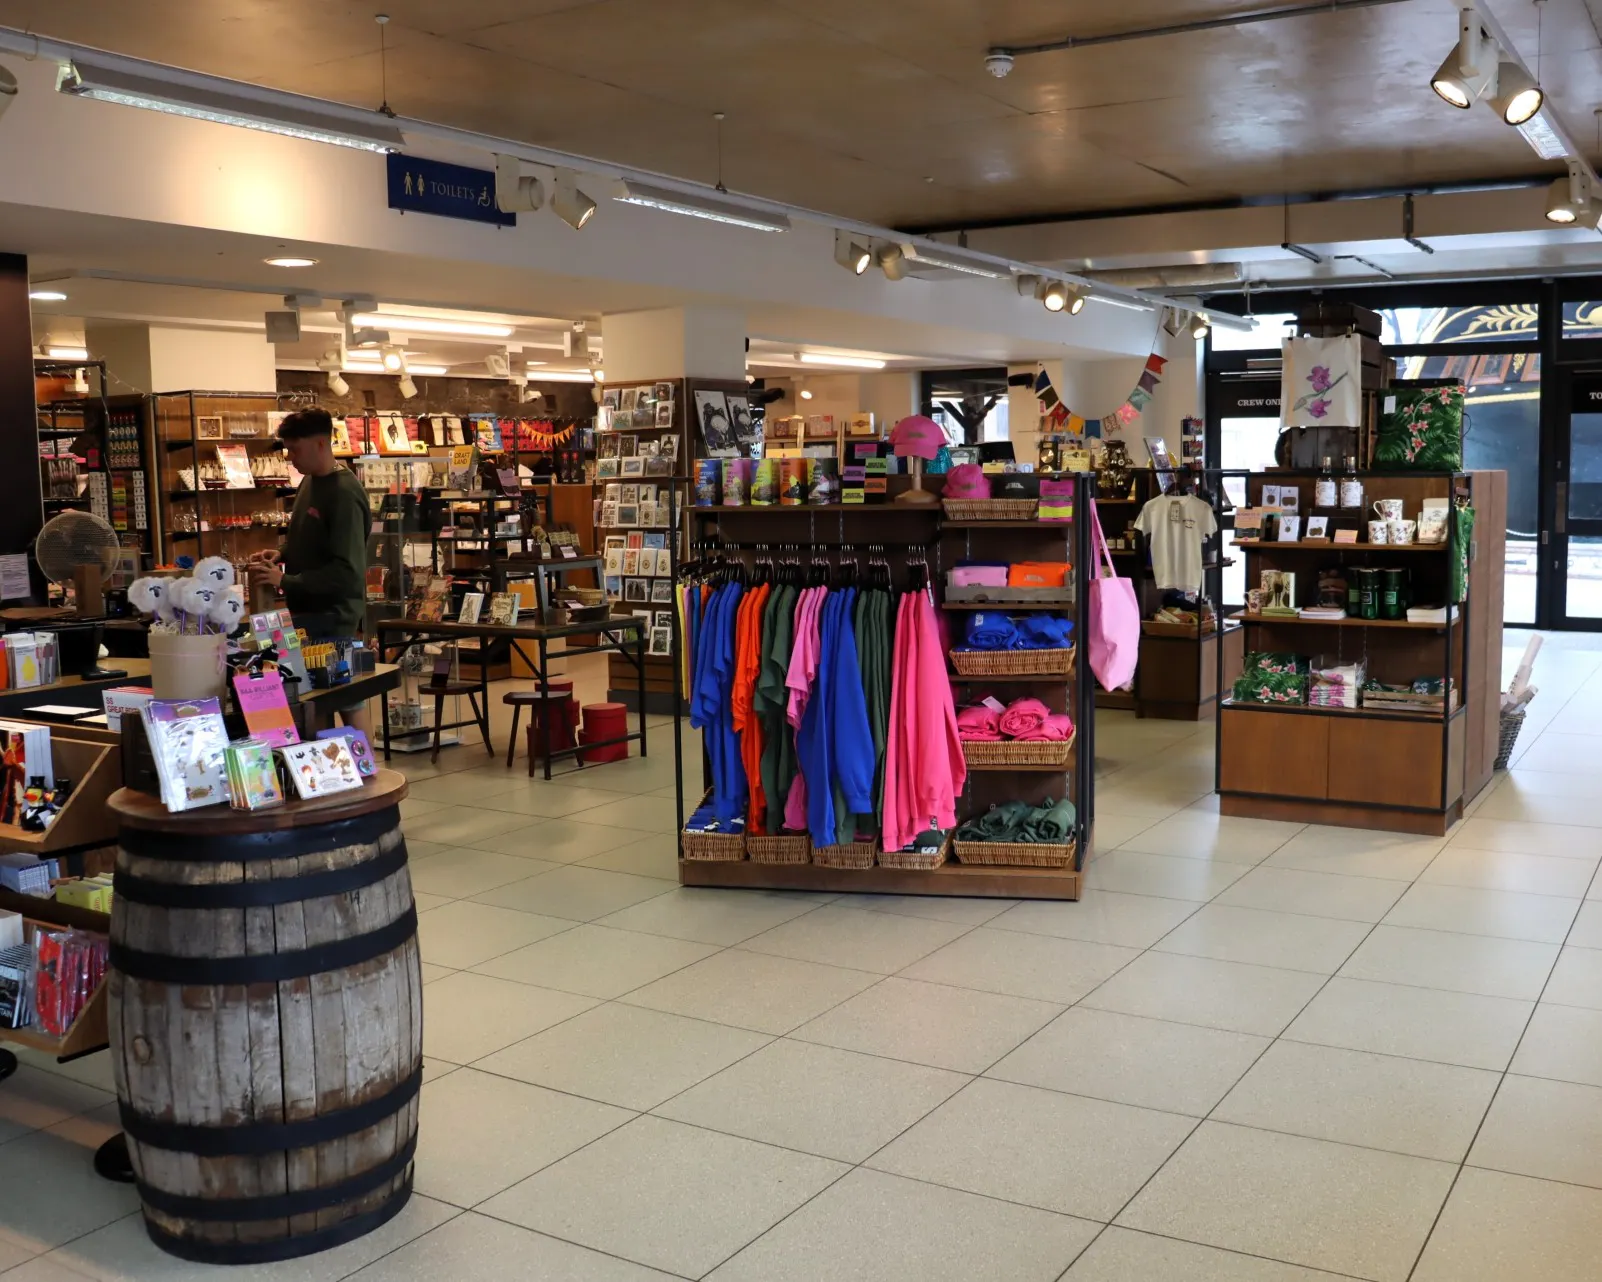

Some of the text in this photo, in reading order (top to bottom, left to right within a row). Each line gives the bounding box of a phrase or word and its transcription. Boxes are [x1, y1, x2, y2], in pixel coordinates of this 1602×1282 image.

[430, 181, 475, 200] TOILETS
[1237, 399, 1264, 407] CREW
[105, 696, 114, 705] SS
[107, 705, 125, 714] GREAT
